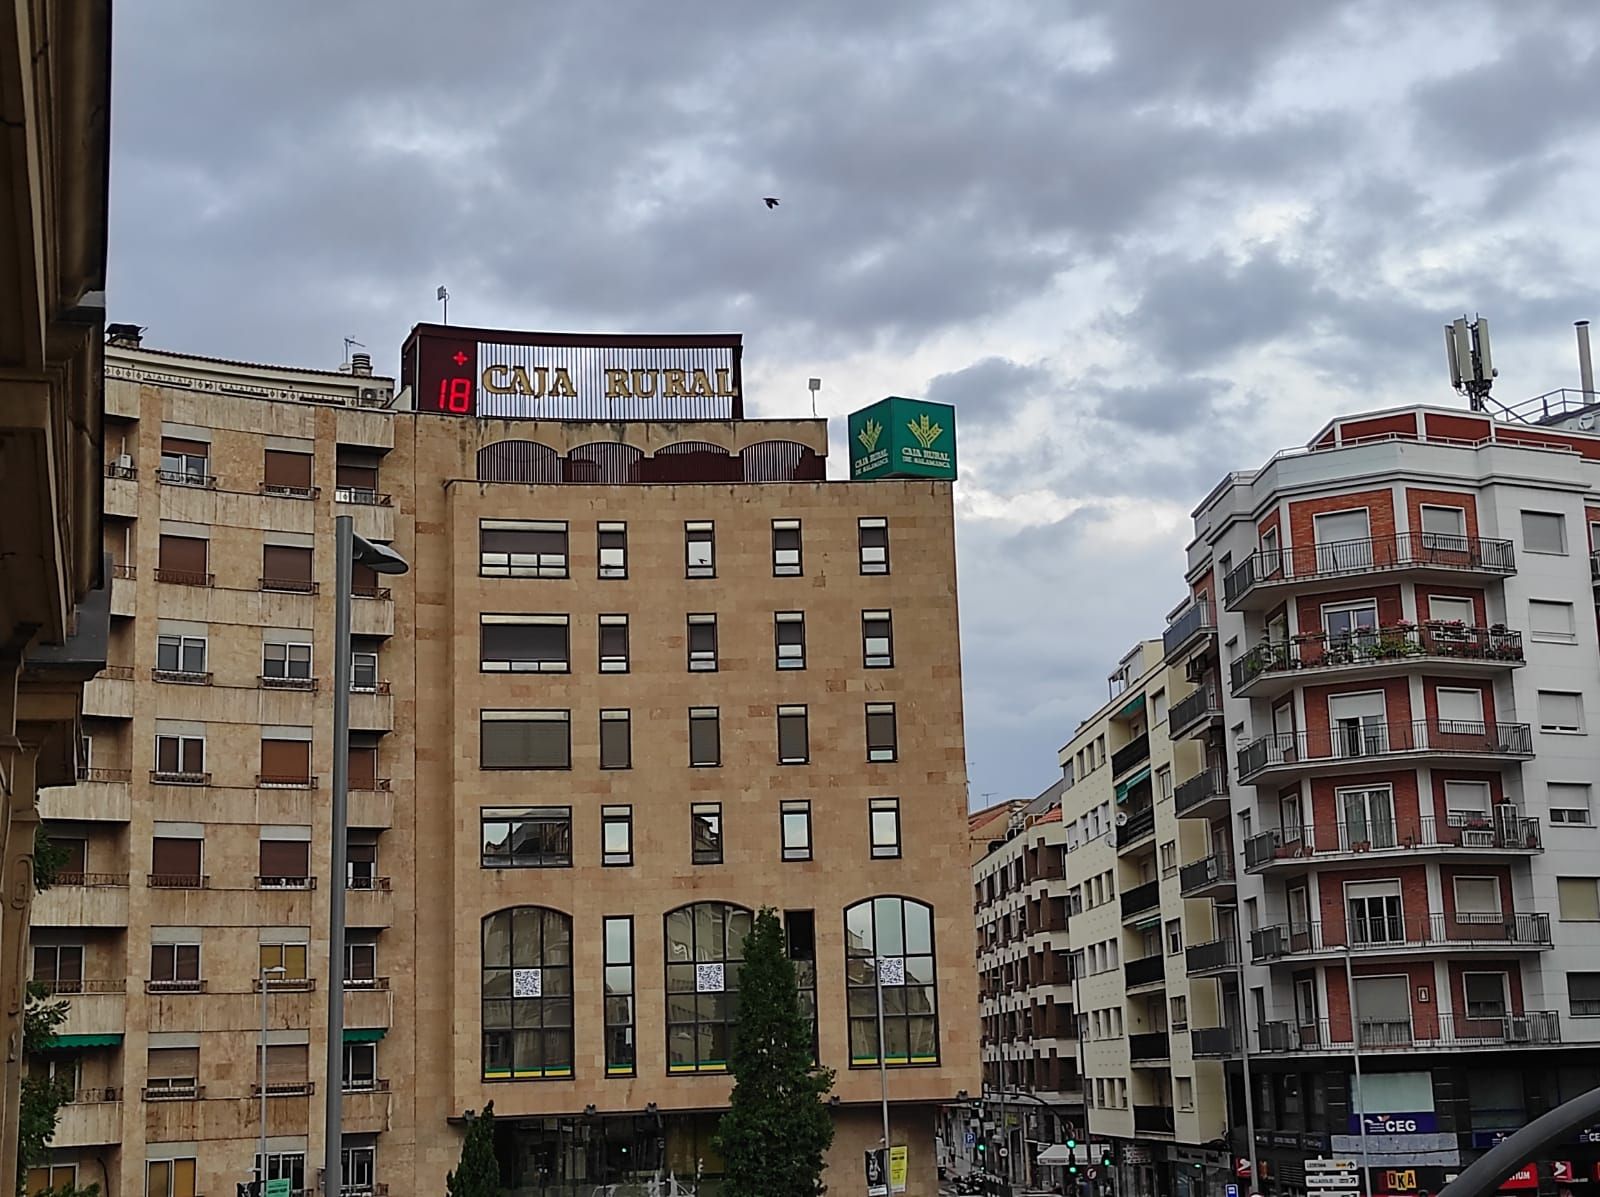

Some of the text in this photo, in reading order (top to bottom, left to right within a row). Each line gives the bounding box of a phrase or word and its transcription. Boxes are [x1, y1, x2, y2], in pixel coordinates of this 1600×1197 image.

[481, 364, 739, 399] CAJA RURAL
[439, 377, 471, 413] 18
[854, 448, 889, 469] CAJA RURAL
[902, 447, 951, 462] CAJA RURAL
[1385, 1120, 1417, 1133] CEG
